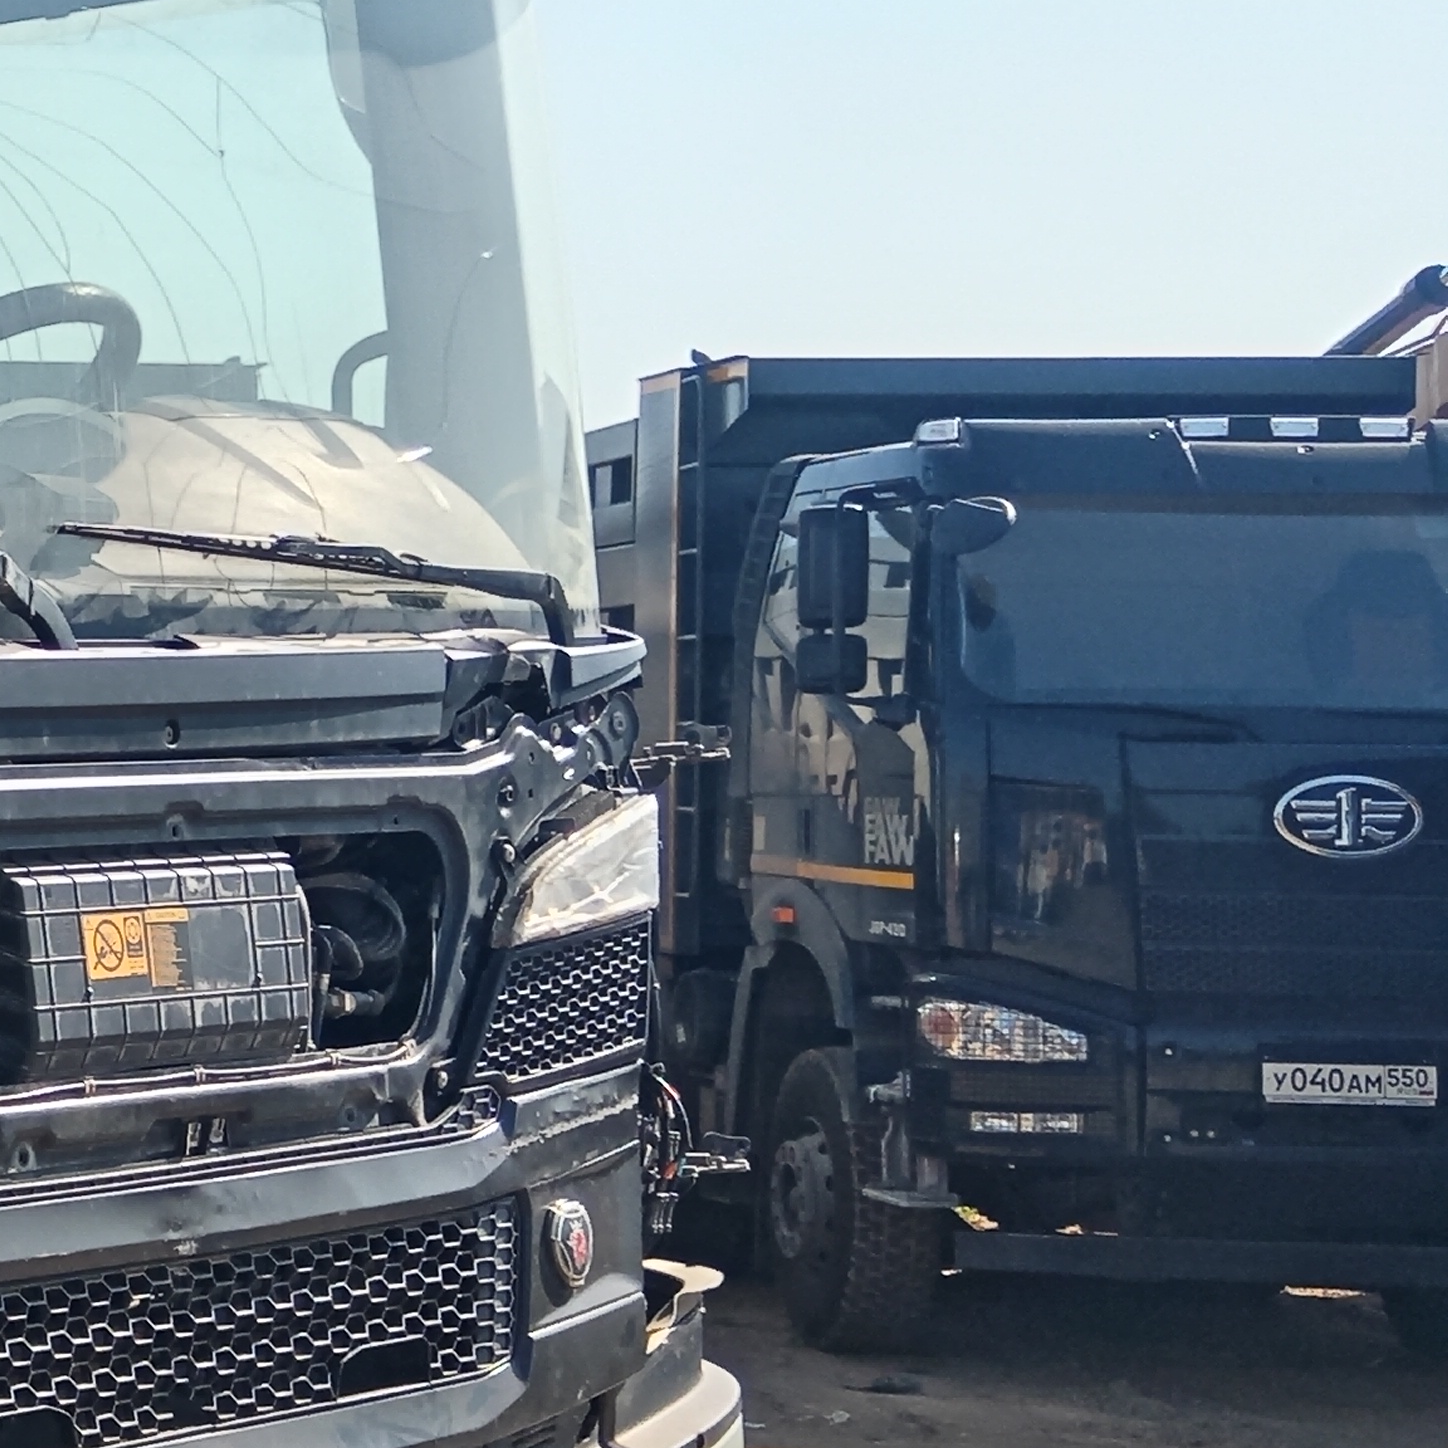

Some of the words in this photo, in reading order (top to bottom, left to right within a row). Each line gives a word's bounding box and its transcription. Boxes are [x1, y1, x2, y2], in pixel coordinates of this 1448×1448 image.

[864, 834, 914, 866] FAW
[1273, 1067, 1383, 1094] У040АМ
[1387, 1068, 1428, 1088] 550
